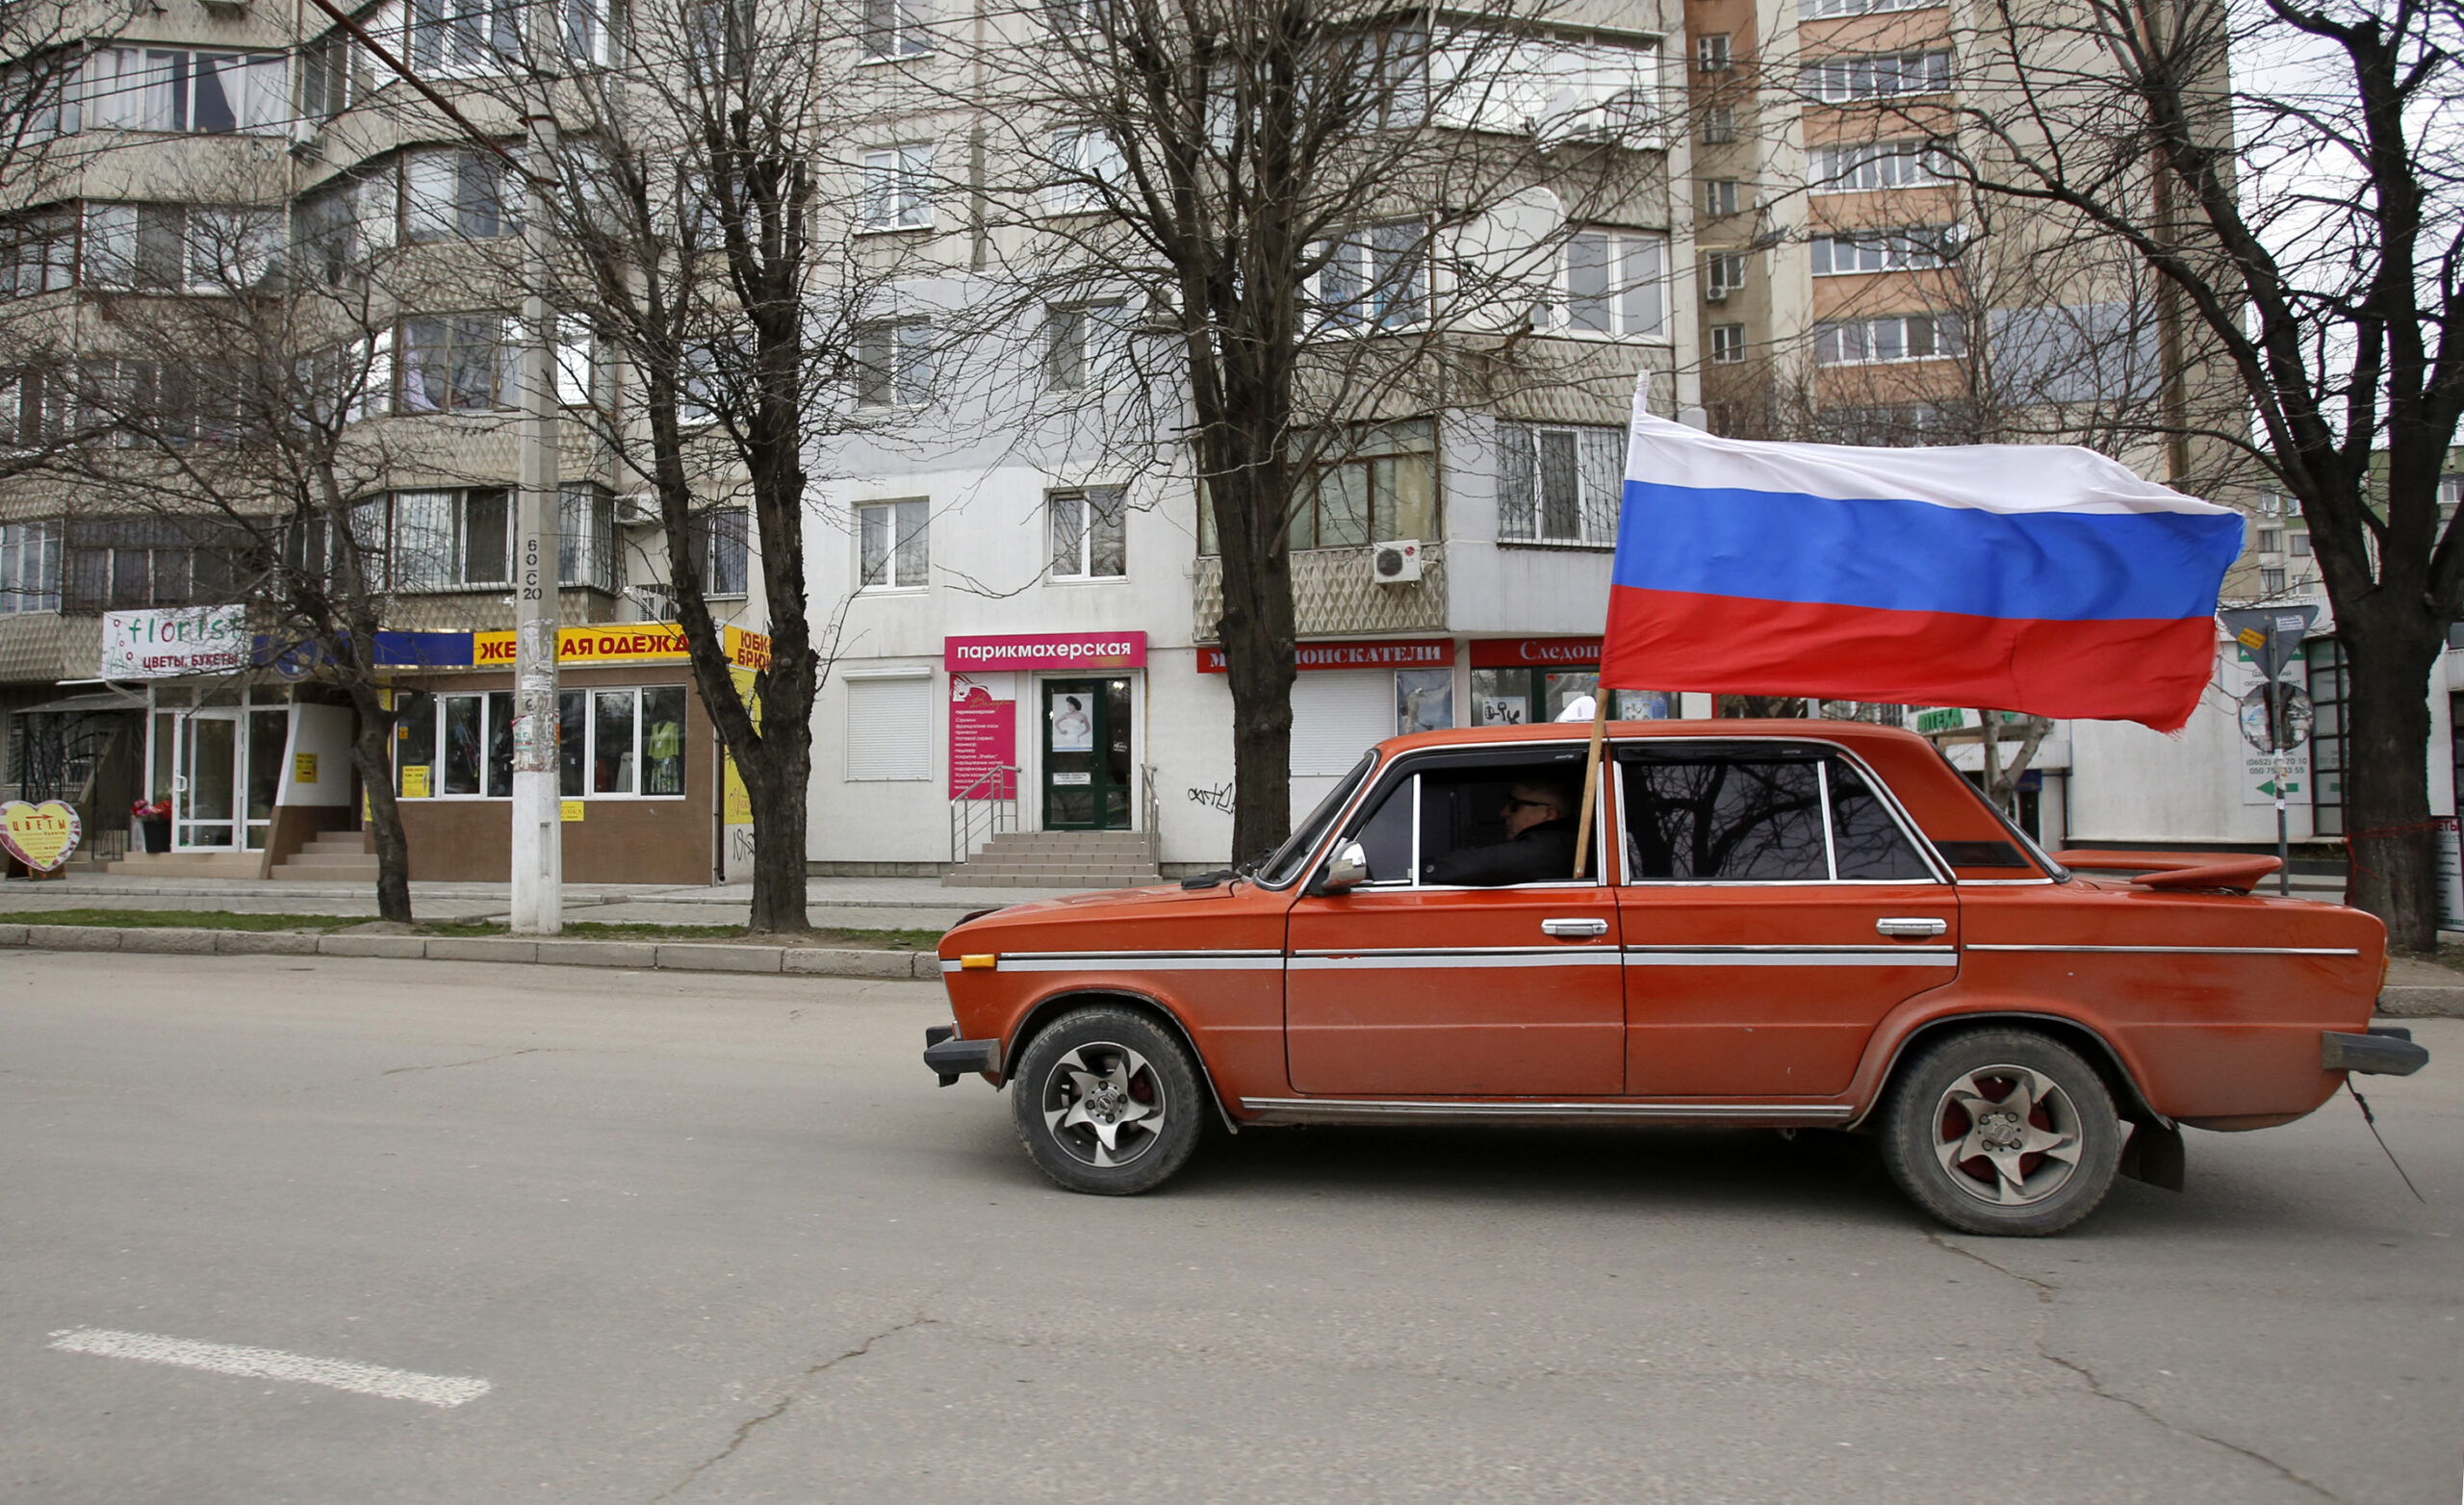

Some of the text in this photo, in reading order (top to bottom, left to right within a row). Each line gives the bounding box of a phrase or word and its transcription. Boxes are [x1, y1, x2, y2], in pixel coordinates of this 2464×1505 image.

[128, 616, 241, 643] florist
[480, 634, 690, 660] ЖЕАЯ ОДЕЖД
[740, 630, 773, 653] ЮБК
[957, 642, 1131, 662] парикмахерская
[1520, 641, 1604, 660] Следоп
[737, 648, 772, 671] БРЮ
[1209, 646, 1441, 668] МОИСКАТЕЛИ
[13, 819, 66, 831] ЦВЕТЫ
